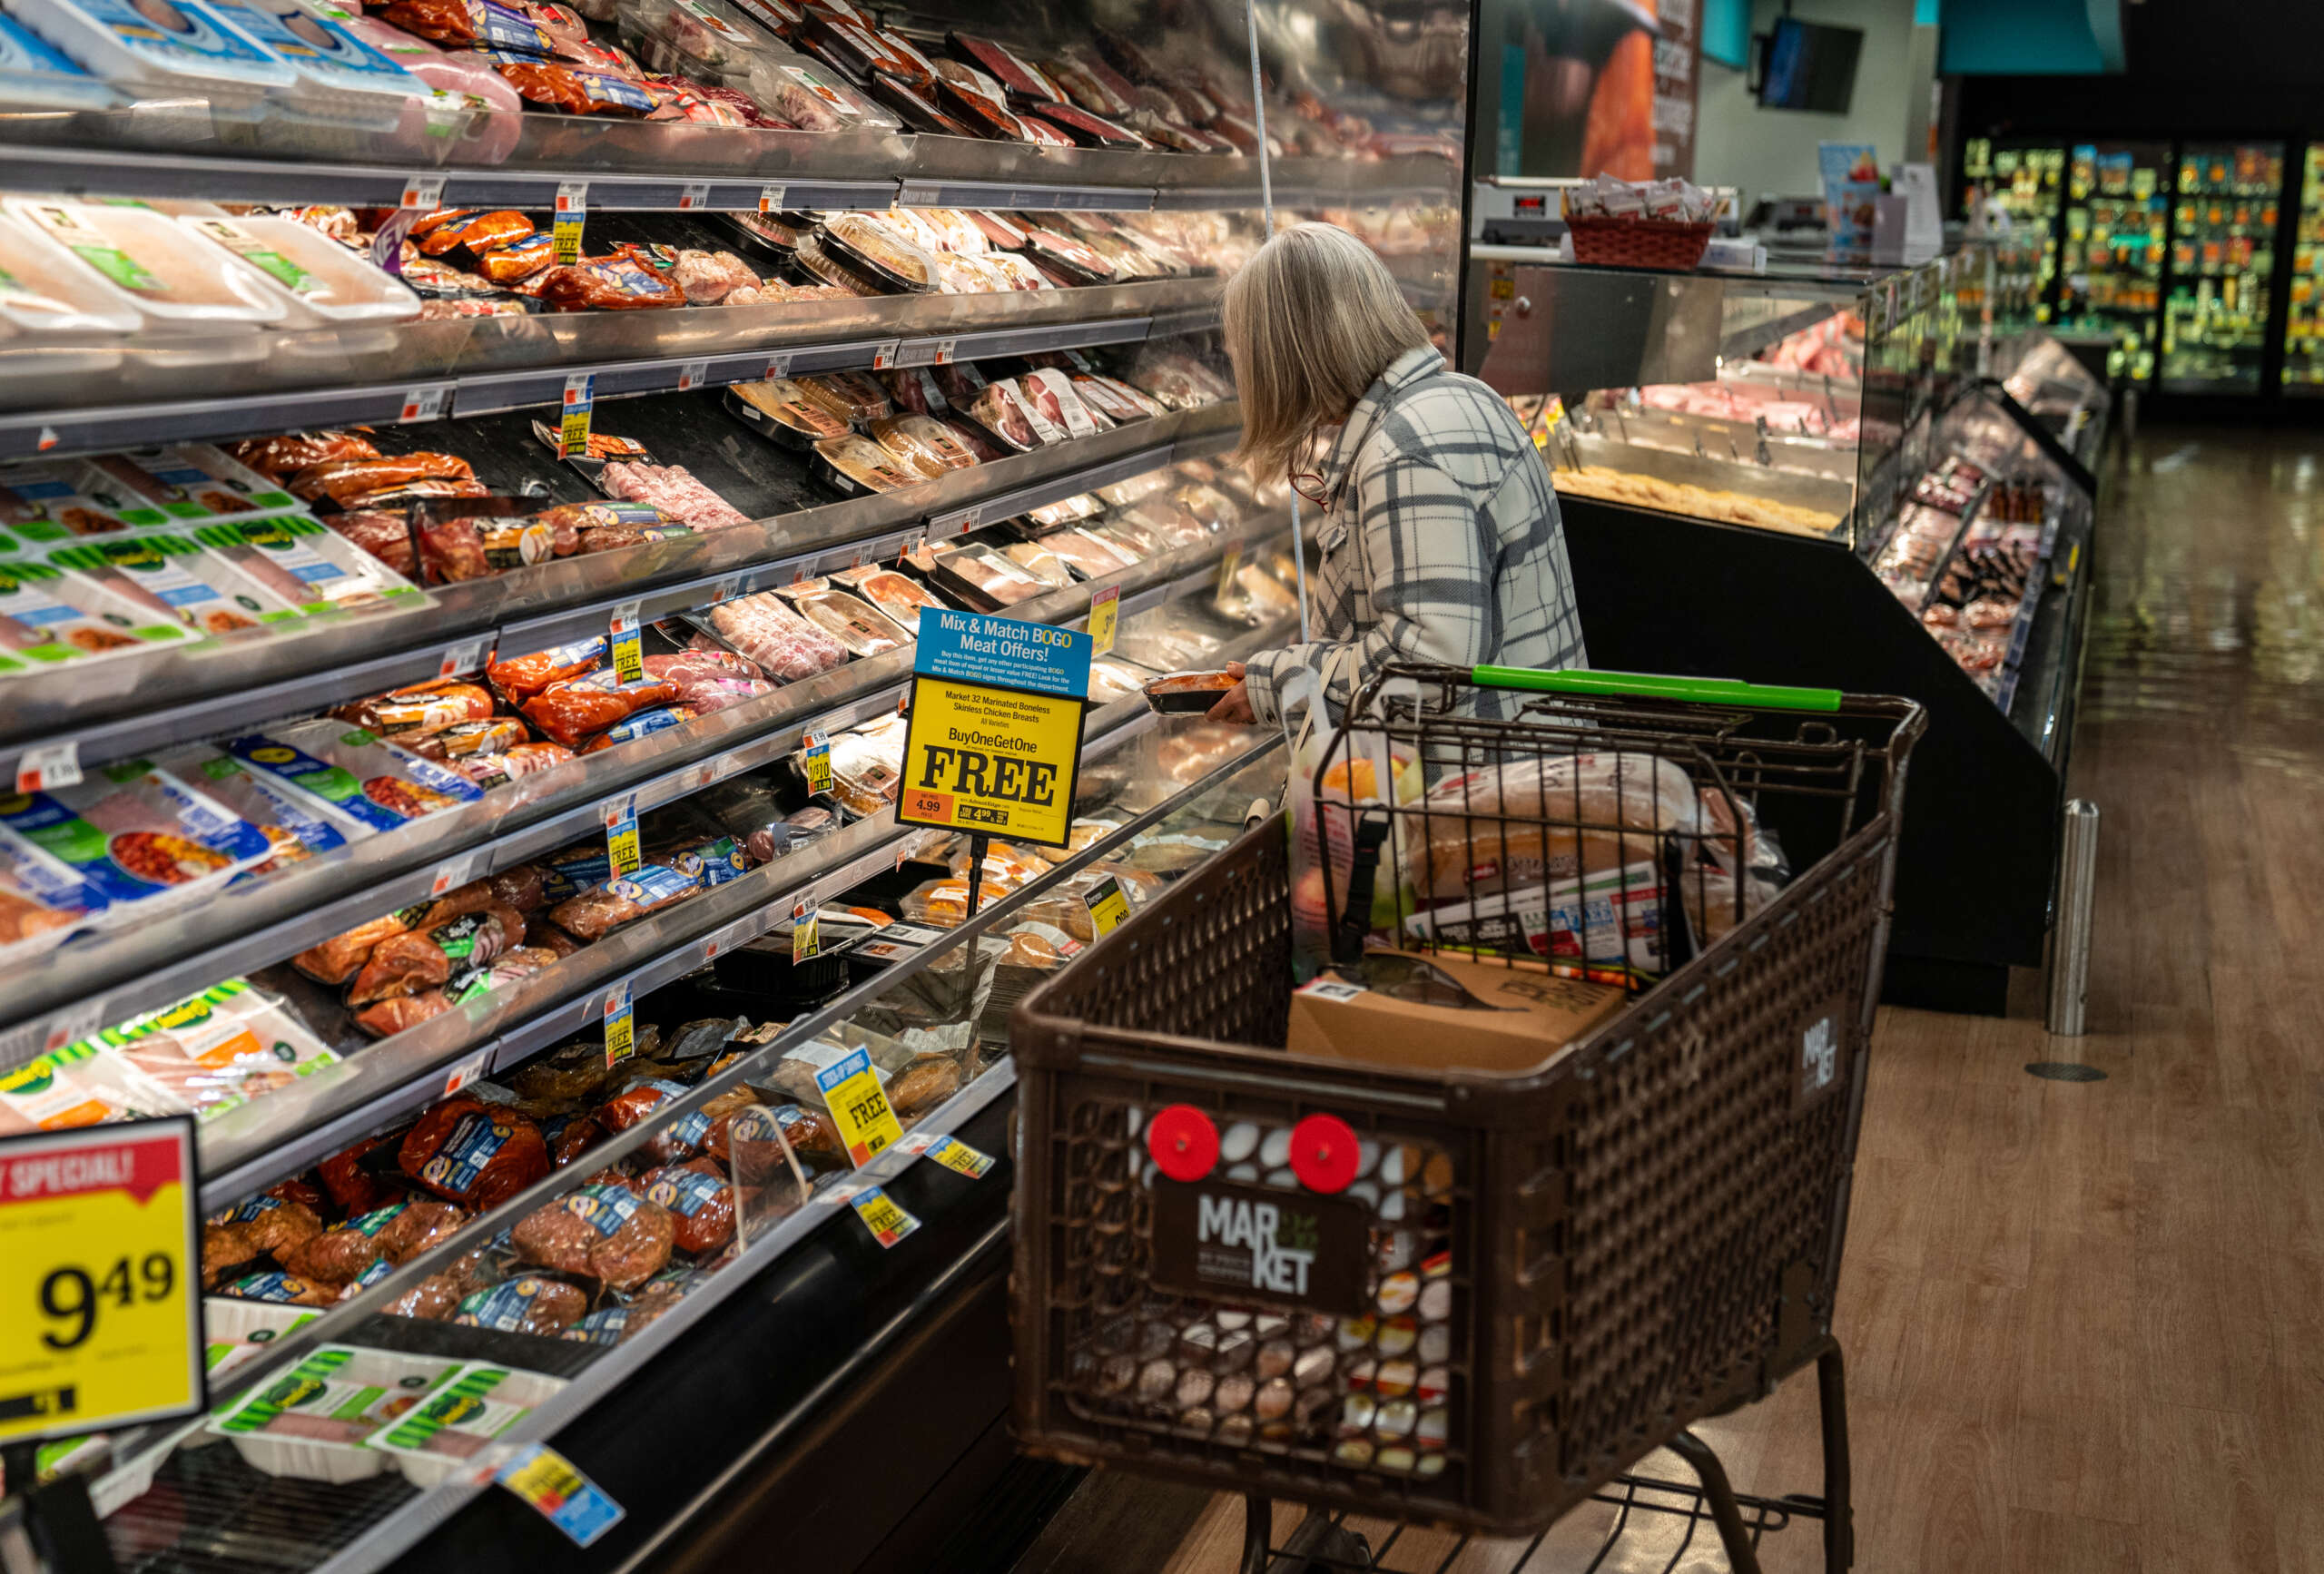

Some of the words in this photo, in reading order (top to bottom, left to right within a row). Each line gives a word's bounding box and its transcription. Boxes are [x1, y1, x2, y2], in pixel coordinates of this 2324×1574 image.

[553, 238, 577, 251] FREE
[562, 428, 586, 443] FREE
[940, 614, 966, 632] Mix
[969, 618, 980, 634] &
[984, 620, 1029, 641] Match
[1032, 627, 1072, 648] BOGO
[960, 635, 997, 654] Meat
[1000, 641, 1049, 663] Offers!
[615, 654, 638, 673] FREE
[941, 650, 951, 658] Buy
[1013, 662, 1047, 673] participating
[998, 675, 1027, 686] throughout
[1038, 681, 1069, 692] department.
[1021, 671, 1037, 679] FREE!
[945, 690, 970, 702] Market
[971, 694, 981, 703] 32
[982, 696, 1018, 709] Marinated
[1019, 702, 1050, 714] Boneless
[953, 703, 982, 713] Skinless
[983, 707, 1011, 719] Chicken
[1012, 712, 1039, 723] Breasts
[989, 719, 1009, 728] Varieties
[949, 727, 1038, 753] BuyOneGetOne
[918, 743, 1058, 808] FREE
[916, 799, 940, 812] 4.99
[611, 845, 635, 866] FREE
[607, 1029, 630, 1052] FREE
[849, 1092, 888, 1129] FREE
[10, 1147, 134, 1197] SPECIAL!
[953, 1150, 978, 1172] FREE
[870, 1208, 904, 1233] FREE
[1197, 1194, 1280, 1247] MAR
[1252, 1246, 1315, 1296] KET
